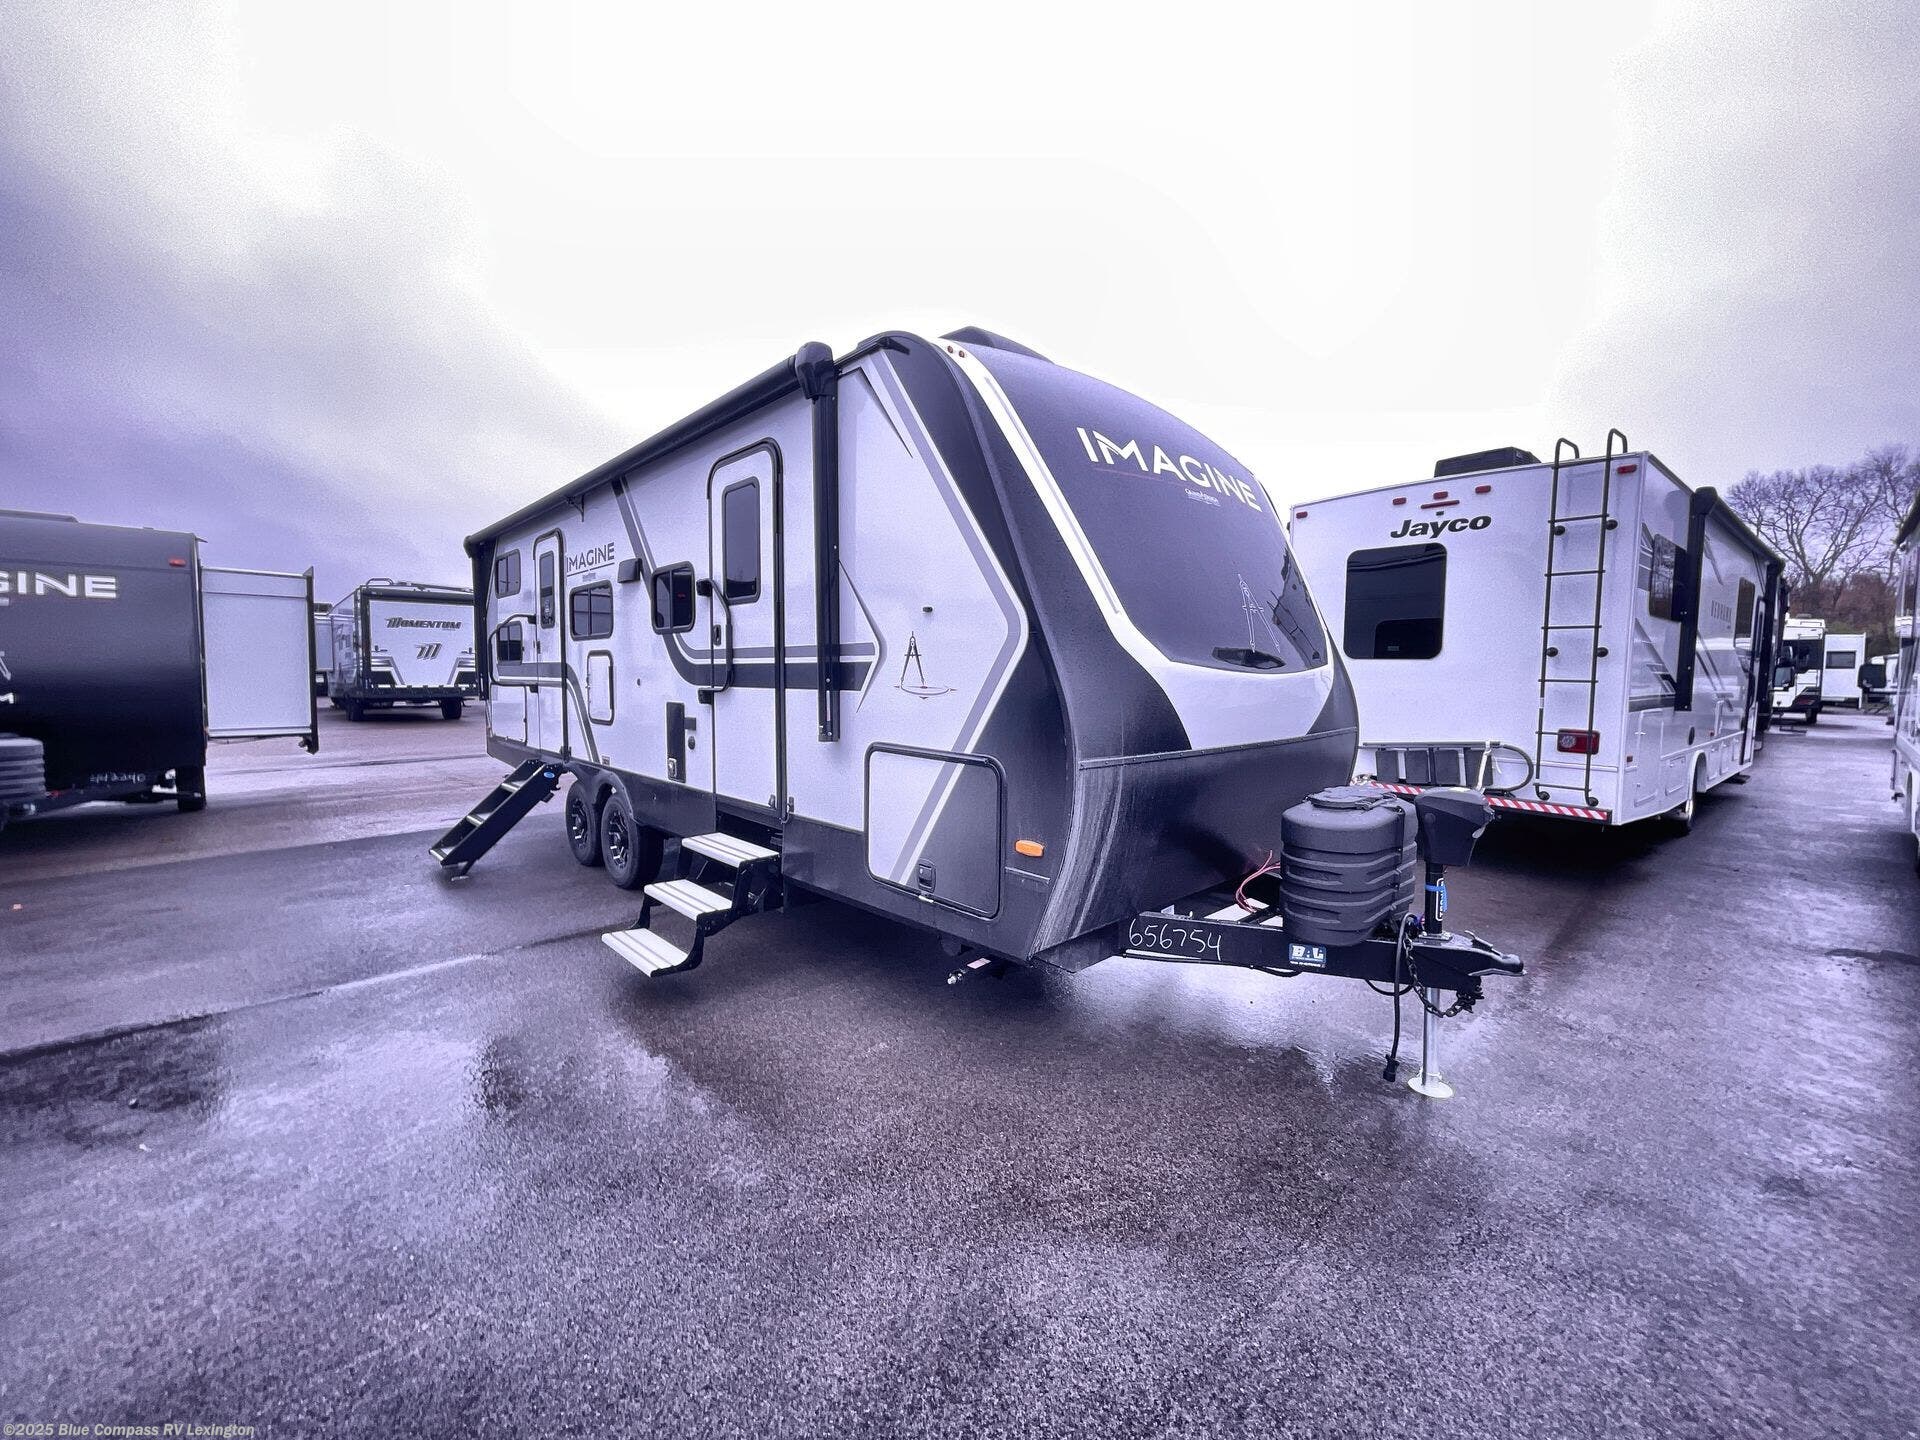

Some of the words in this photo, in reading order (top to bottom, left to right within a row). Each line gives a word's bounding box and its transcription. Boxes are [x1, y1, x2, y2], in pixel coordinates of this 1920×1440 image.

[1076, 427, 1262, 512] IMAGINE
[1390, 516, 1492, 539] Jayco
[566, 542, 614, 572] IMAGINE
[385, 617, 462, 629] MOMENTUM
[1129, 919, 1221, 961] 656754
